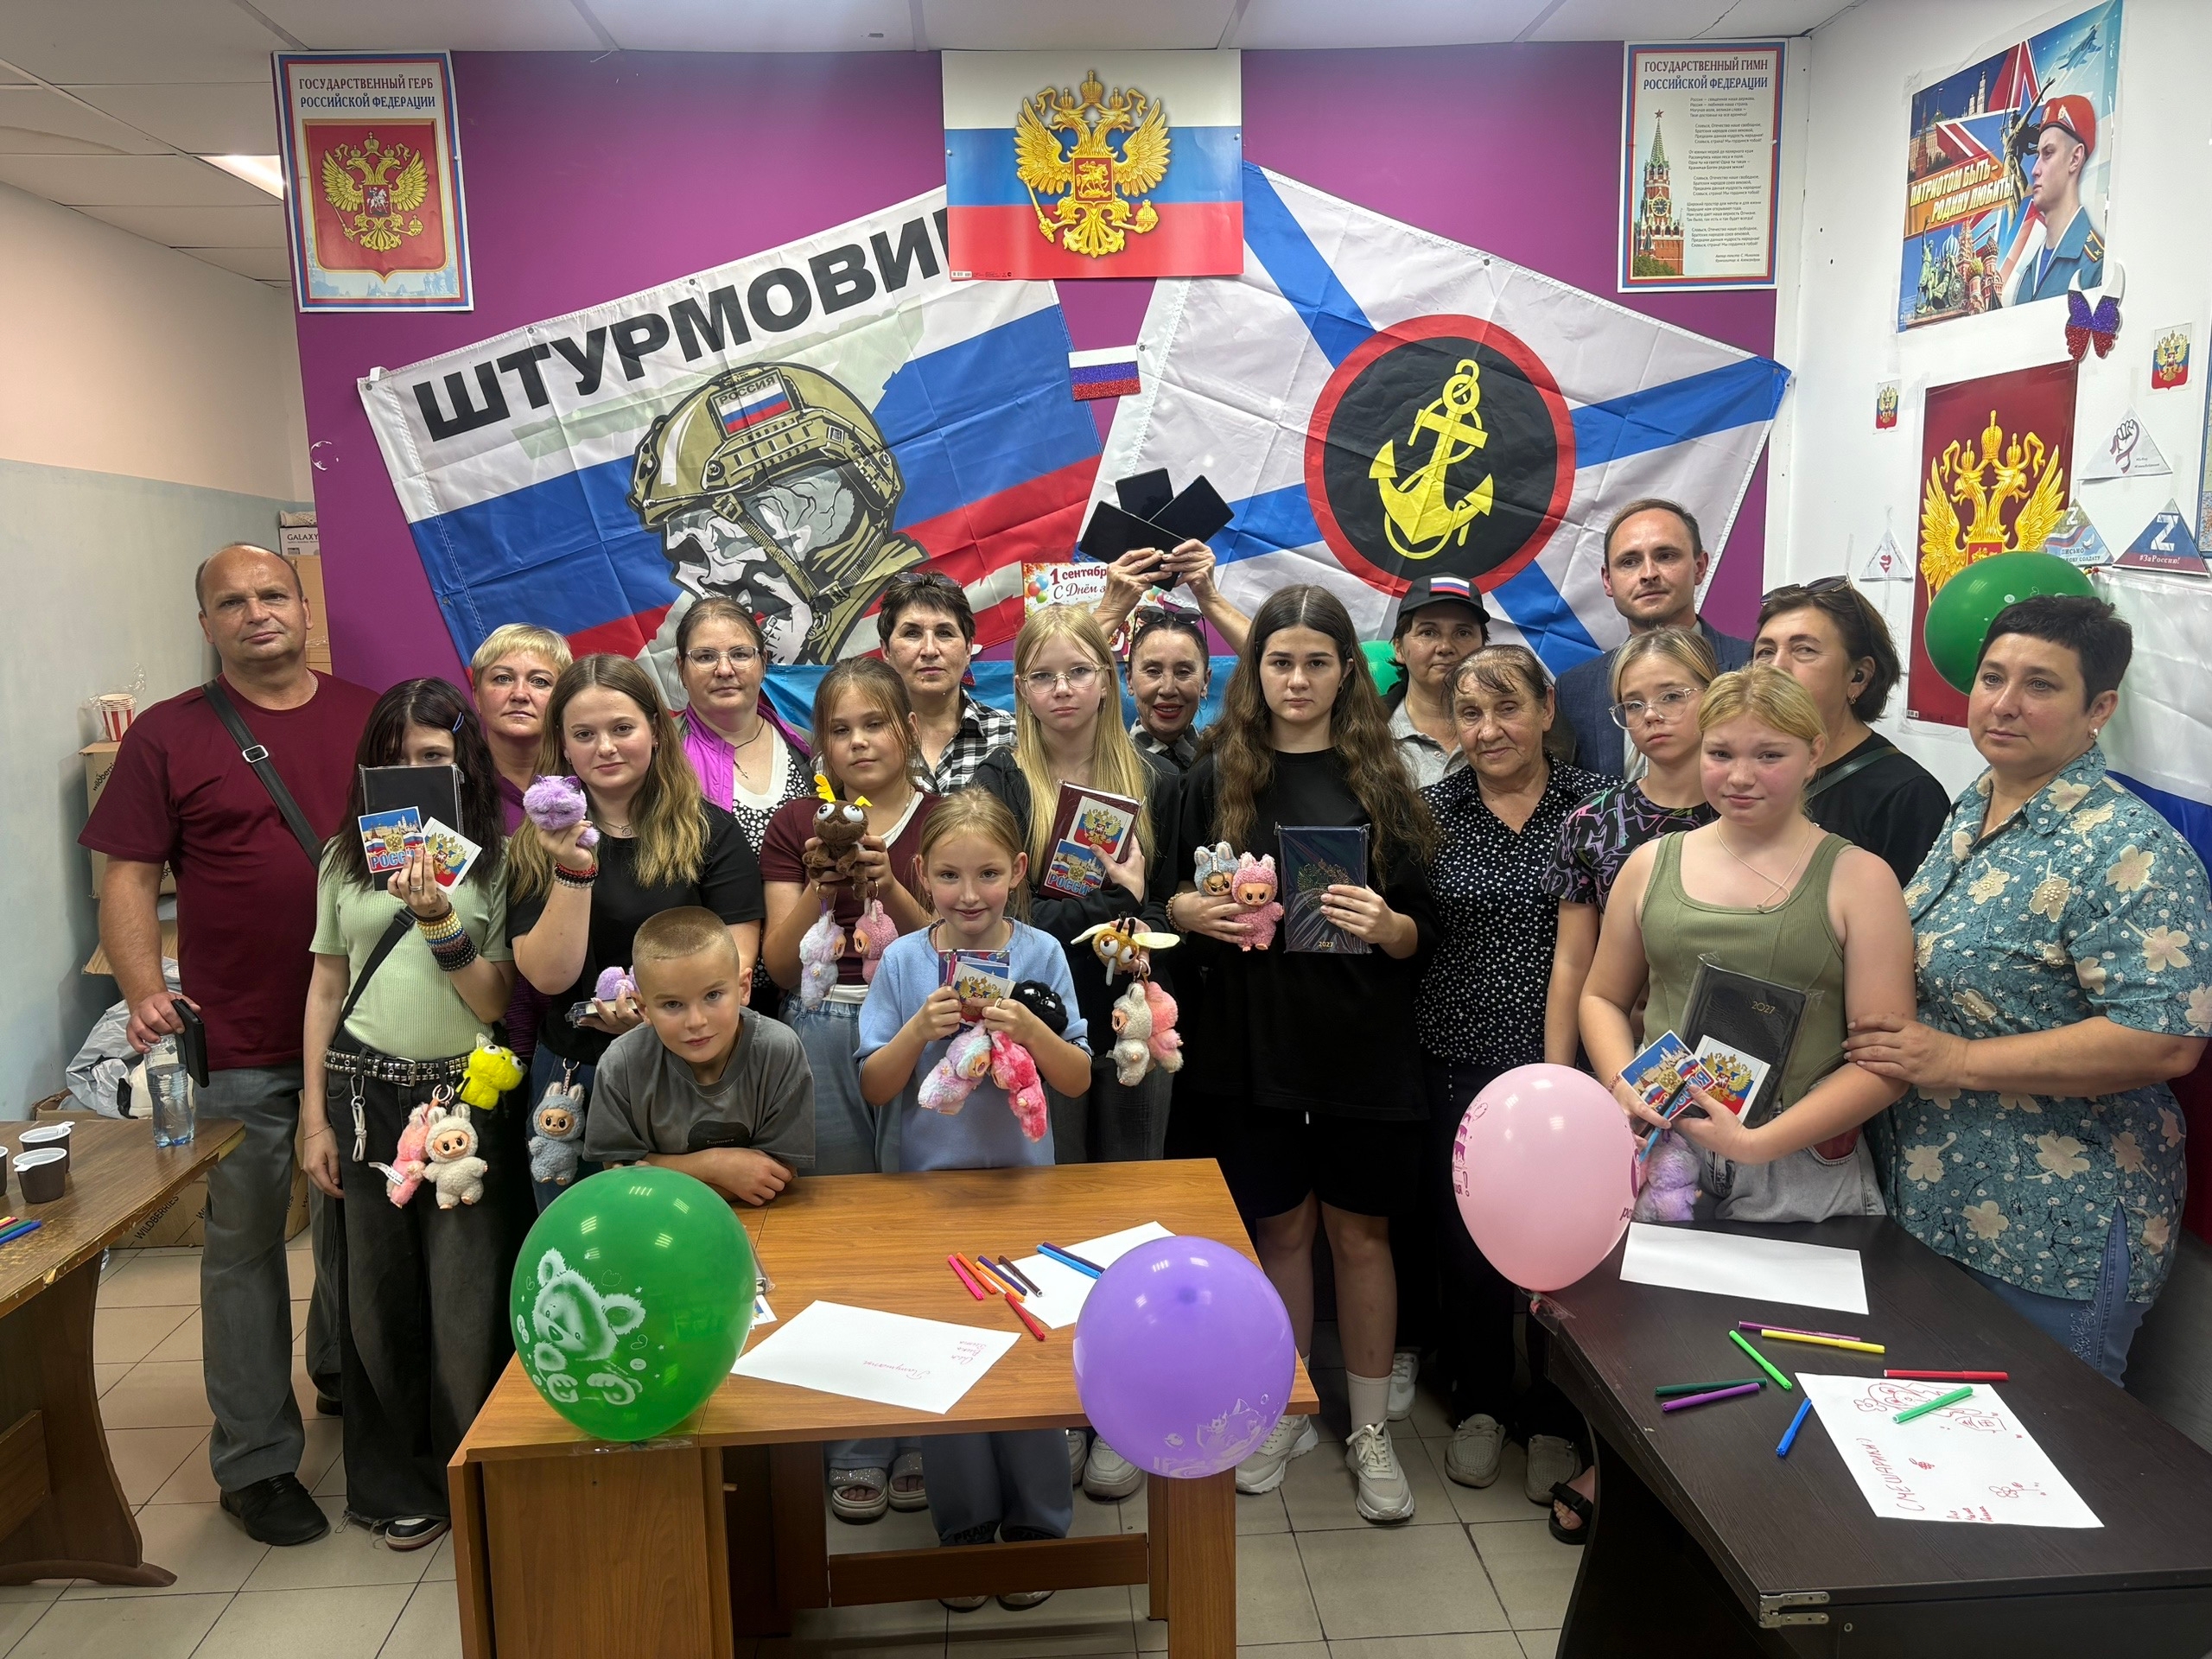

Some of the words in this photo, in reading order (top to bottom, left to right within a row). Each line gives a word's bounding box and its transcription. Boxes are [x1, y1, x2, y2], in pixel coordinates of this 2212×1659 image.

[1644, 56, 1739, 73] ГОСУДАРСТВЕННЫЙ
[1741, 60, 1768, 71] ГИМН
[299, 73, 406, 92] ГОСУДАРСТВЕННЫЙ
[408, 77, 434, 89] ГЕРБ
[1643, 75, 1707, 90] РОССИЙСКОЙ
[1709, 77, 1768, 91] ФЕДЕРАЦИИ
[300, 92, 370, 108] РОССИЙСКОЙ
[372, 96, 435, 110] ФЕДЕРАЦИИ
[1910, 168, 1963, 207] ПАТРИОТОМ
[1962, 158, 1991, 188] БЫТЬ
[1930, 190, 1971, 223] РОДИНУ
[1968, 174, 2015, 210] ЛЮБИТЬ!
[411, 207, 949, 442] ШТУРМОВИ
[719, 376, 776, 404] РОССИЯ
[2151, 514, 2179, 551] Z
[1050, 568, 1060, 586] 1
[1062, 565, 1107, 580] сентябр
[1053, 585, 1064, 600] С
[1065, 582, 1098, 597] Днём
[92, 762, 116, 791] wildberri
[370, 849, 415, 869] РОСС
[1048, 873, 1093, 895] РОССИ
[1751, 1001, 1776, 1014] 2027
